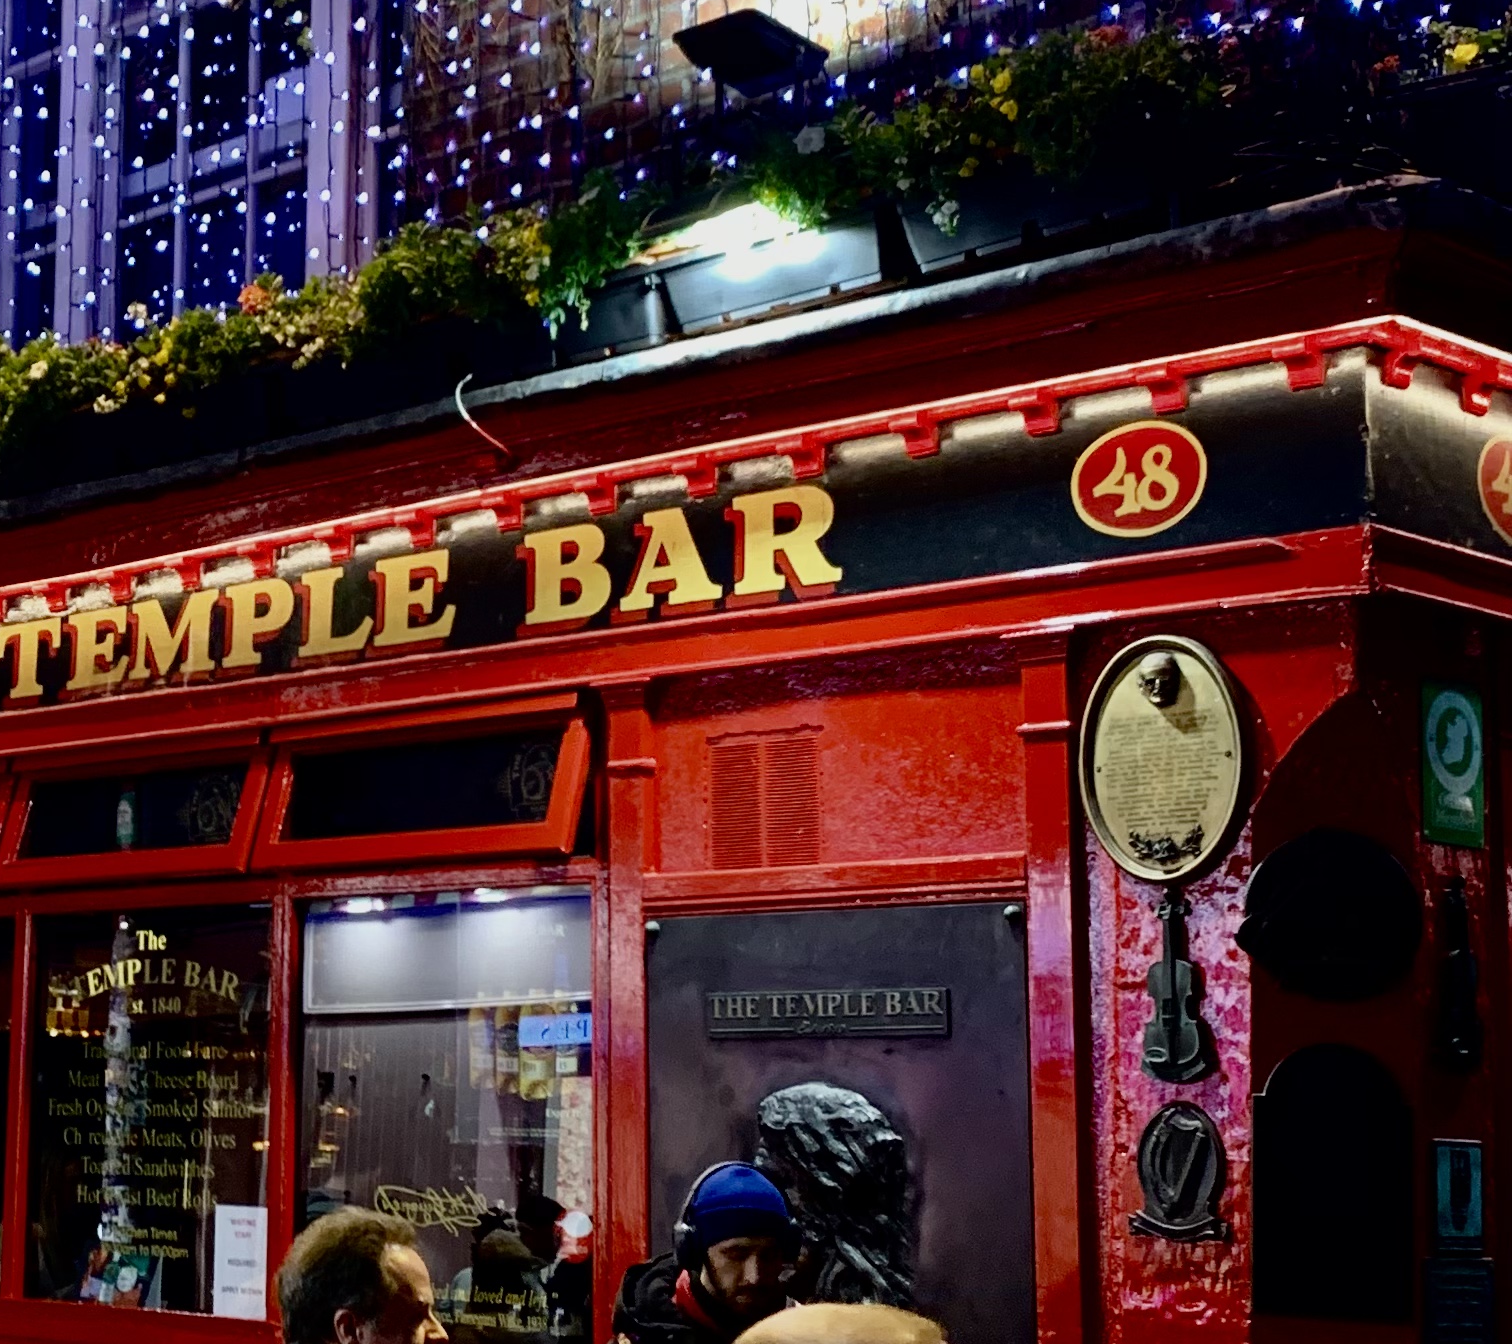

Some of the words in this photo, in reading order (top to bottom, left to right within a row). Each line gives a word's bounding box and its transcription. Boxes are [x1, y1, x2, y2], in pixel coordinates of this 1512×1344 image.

[1092, 444, 1179, 517] 48
[1491, 450, 1512, 515] 4
[520, 484, 843, 626] BAR
[136, 929, 168, 951] The
[75, 958, 176, 998] TEMPLE
[184, 960, 239, 1003] BAR
[152, 996, 181, 1015] 1840
[711, 996, 759, 1018] THE
[766, 993, 875, 1017] TEMPLE
[885, 991, 944, 1015] BAR
[157, 1042, 190, 1059] Food
[68, 1070, 99, 1088] Meat
[196, 1069, 238, 1089] Board
[48, 1098, 82, 1117] Fresh
[146, 1099, 198, 1119] Smoked
[142, 1128, 186, 1149] Meats,
[190, 1129, 236, 1150] Olives
[77, 1183, 101, 1204] Hot
[146, 1187, 179, 1207] Beef
[474, 1285, 504, 1305] loved
[505, 1290, 527, 1306] and
